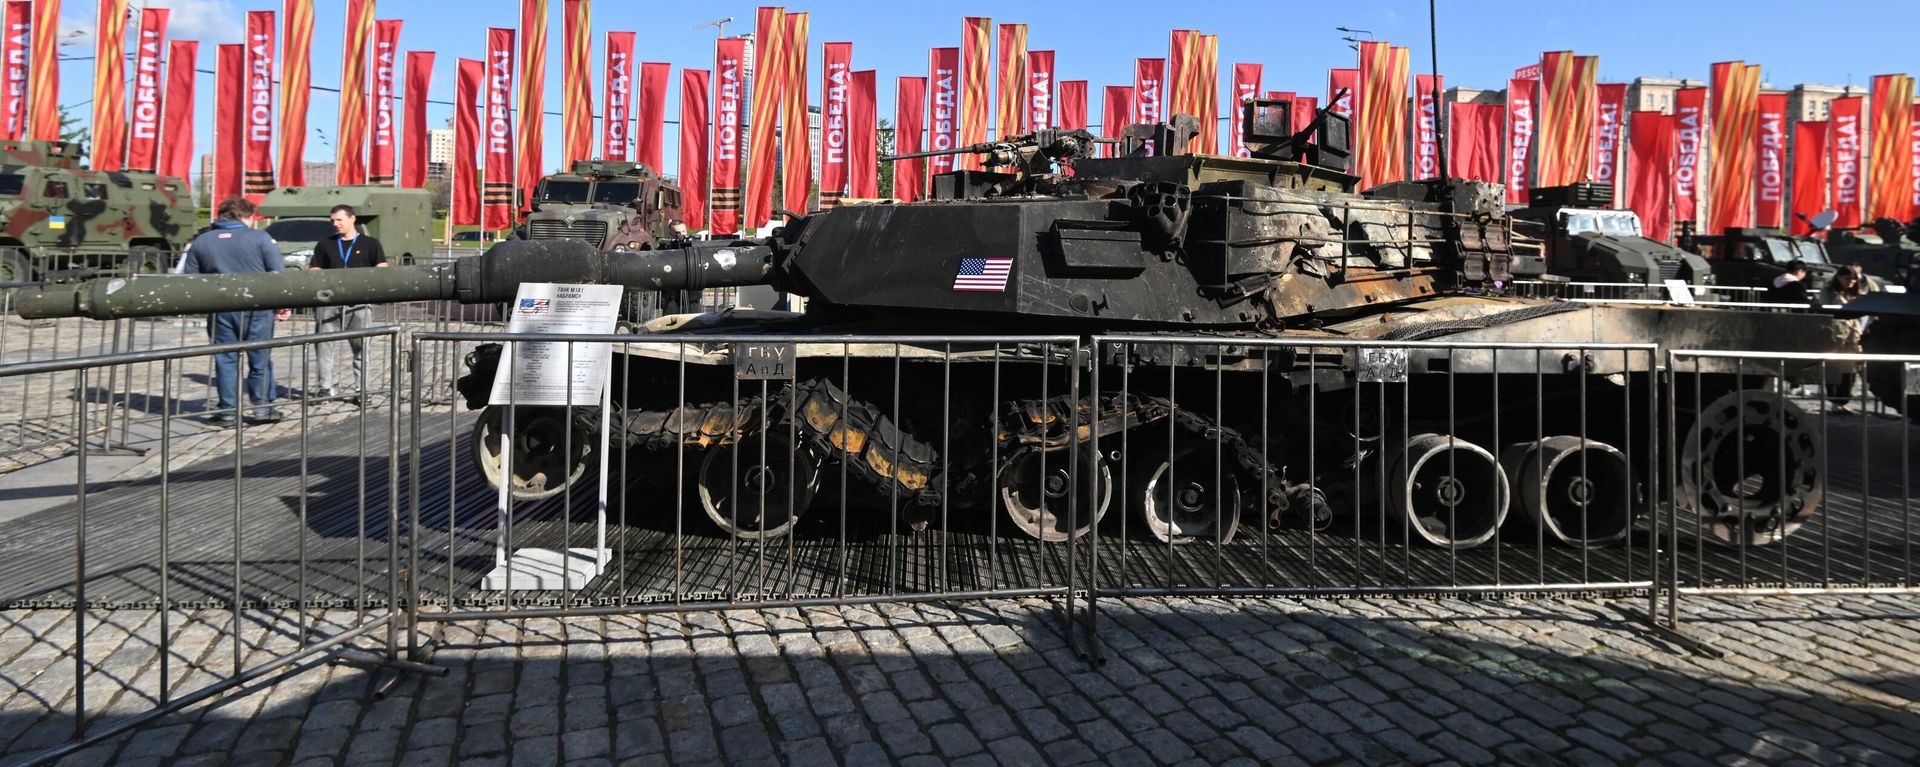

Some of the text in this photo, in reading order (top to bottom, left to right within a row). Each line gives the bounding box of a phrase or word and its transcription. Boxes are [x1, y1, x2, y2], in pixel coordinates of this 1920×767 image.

[252, 33, 271, 142] ПОБЕДА!
[490, 50, 510, 154] ПОБЕДА!
[609, 52, 628, 156] ПОБЕДА!
[719, 58, 740, 160] ПОБЕДА!
[827, 62, 848, 164] ПОБЕДА!
[935, 68, 955, 167] ПОБЕДА!
[1032, 72, 1051, 132] БЕДА!
[1511, 98, 1534, 191] ПОБЕДА!
[1597, 103, 1618, 184] ОБЕДА!
[1676, 106, 1699, 196] ПОБЕДА!
[1762, 112, 1783, 201] ПОБЕДА!
[1837, 115, 1860, 203] ПОБЕДА!
